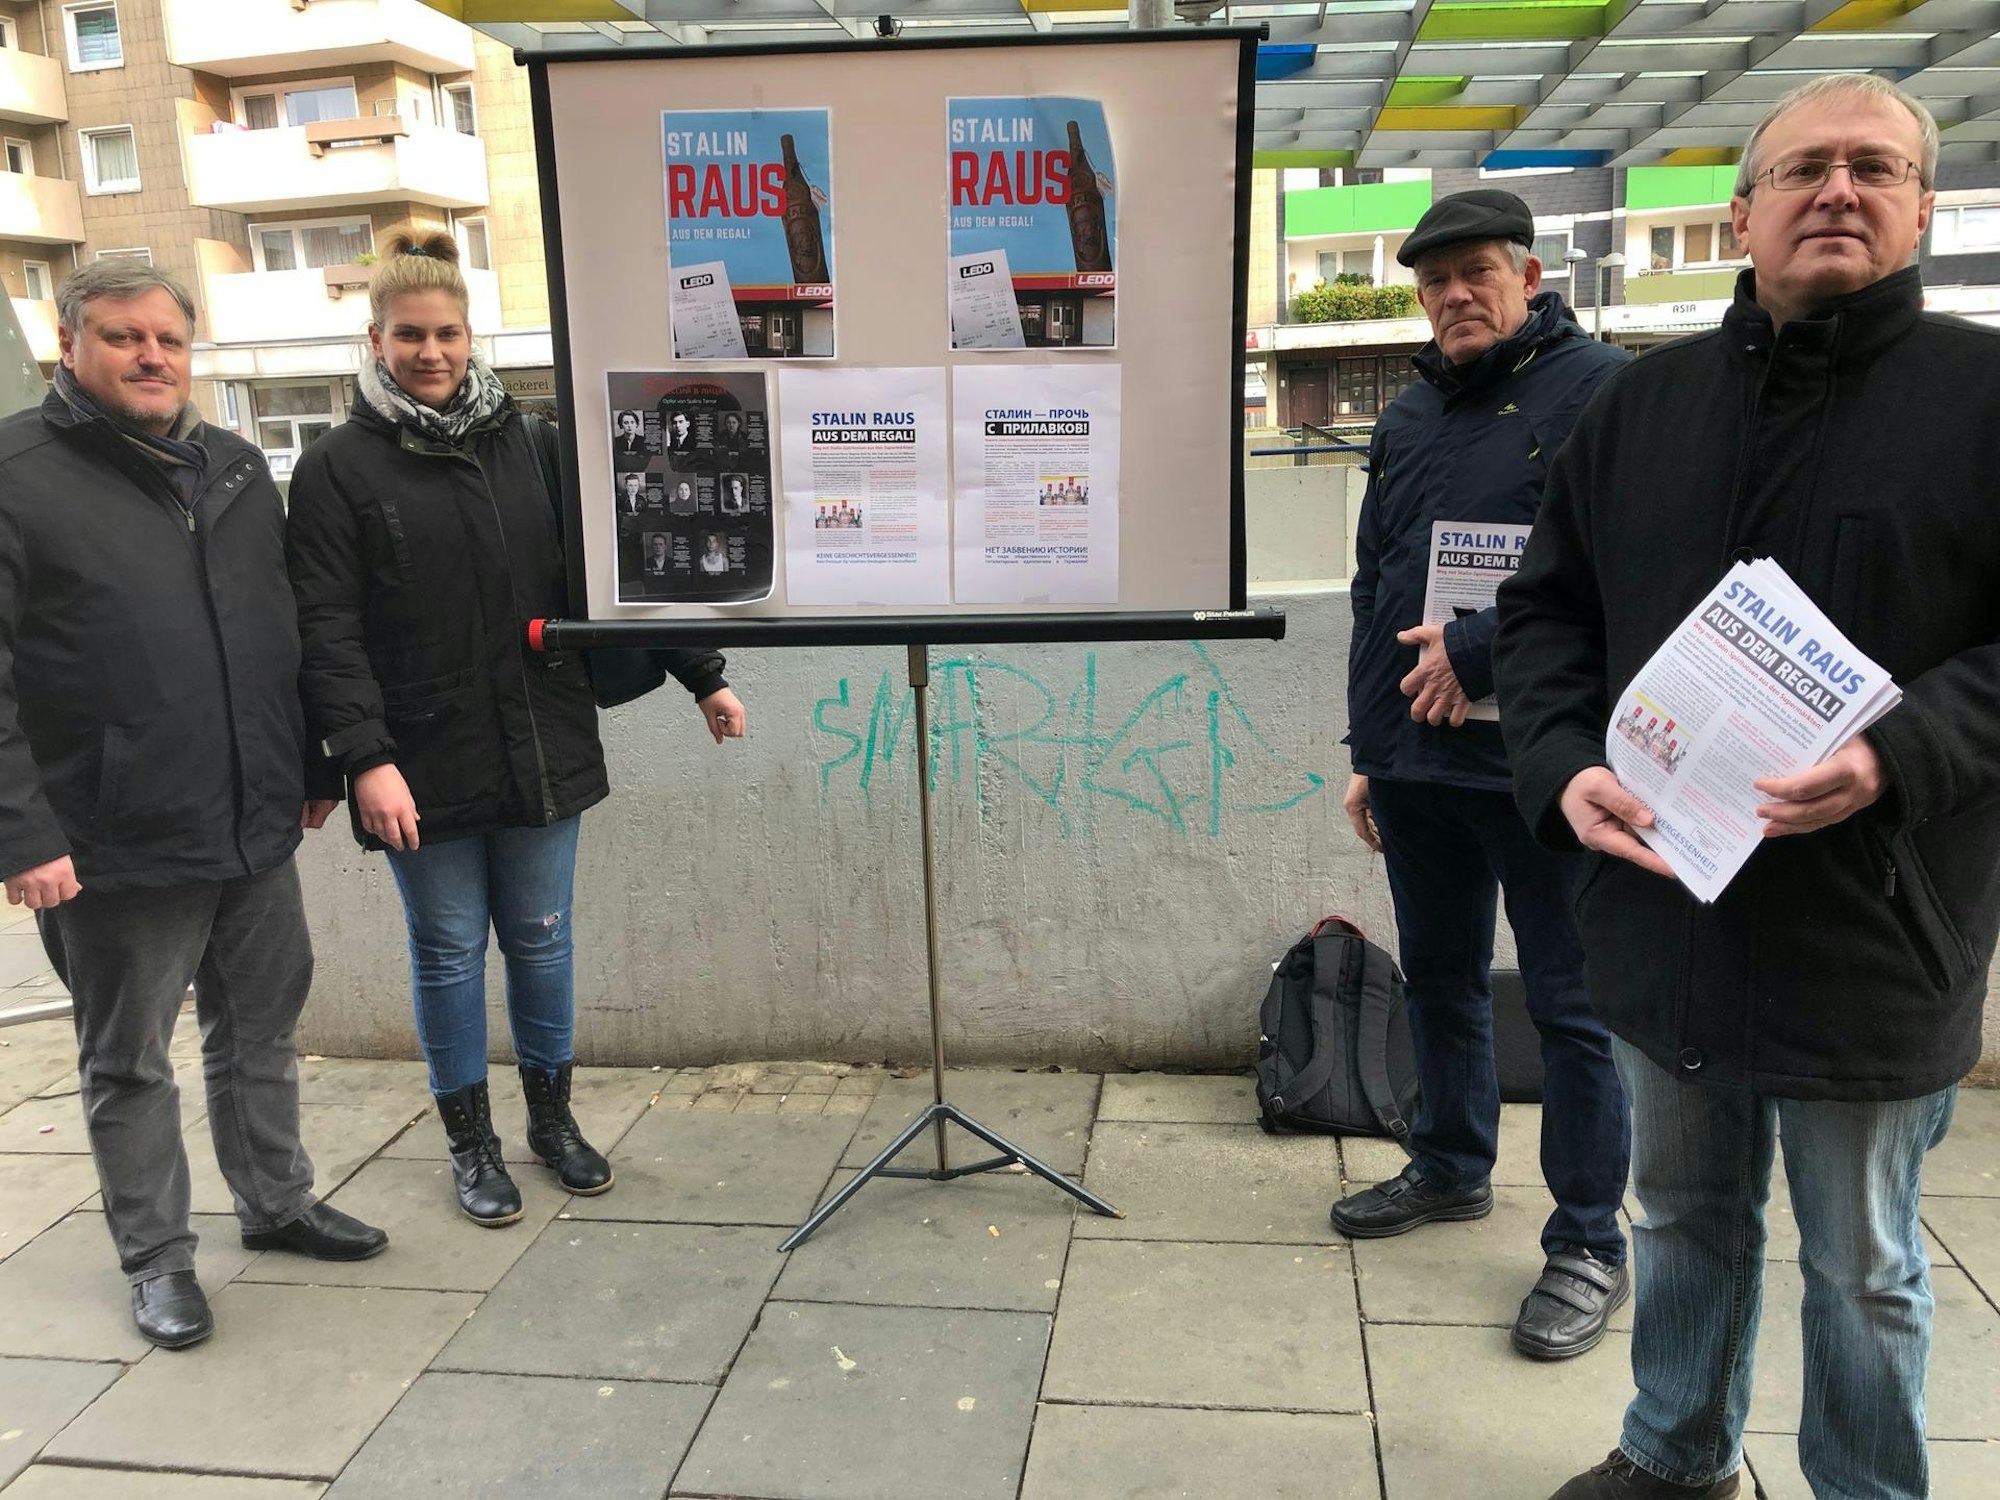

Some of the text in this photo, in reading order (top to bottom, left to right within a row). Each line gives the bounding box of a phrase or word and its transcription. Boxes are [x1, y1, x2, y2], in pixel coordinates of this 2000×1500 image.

[953, 118, 1033, 142] STALIN
[667, 131, 748, 157] STALIN
[952, 150, 1072, 206] RAUS
[668, 164, 787, 218] RAUS
[954, 216, 1033, 228] AUS DEM REGAL!
[672, 228, 750, 240] AUS DEM REGAL!
[962, 263, 992, 277] LEDO
[682, 276, 713, 289] LEDO
[1078, 275, 1114, 286] LEDO
[796, 286, 832, 296] LEDO
[1672, 304, 1696, 314] ASIA
[812, 412, 914, 426] STALIN RAUS
[986, 410, 1032, 418] СТАЛИН
[1050, 409, 1089, 418] ПРОЧЬ
[987, 423, 1088, 434] С ПРИЛАВКОВ!
[814, 430, 914, 442] AUS DEM REGAL!
[1440, 532, 1506, 549] STALIN
[1440, 552, 1469, 566] AUS
[1473, 556, 1505, 568] DEM
[1724, 580, 1802, 646] STALIN
[1798, 639, 1866, 696] RAUS
[1705, 606, 1743, 638] AUS
[1738, 631, 1780, 668] DEM
[1774, 660, 1840, 717] REGAL!
[1617, 780, 1718, 874] SVERGESSENHEIT!
